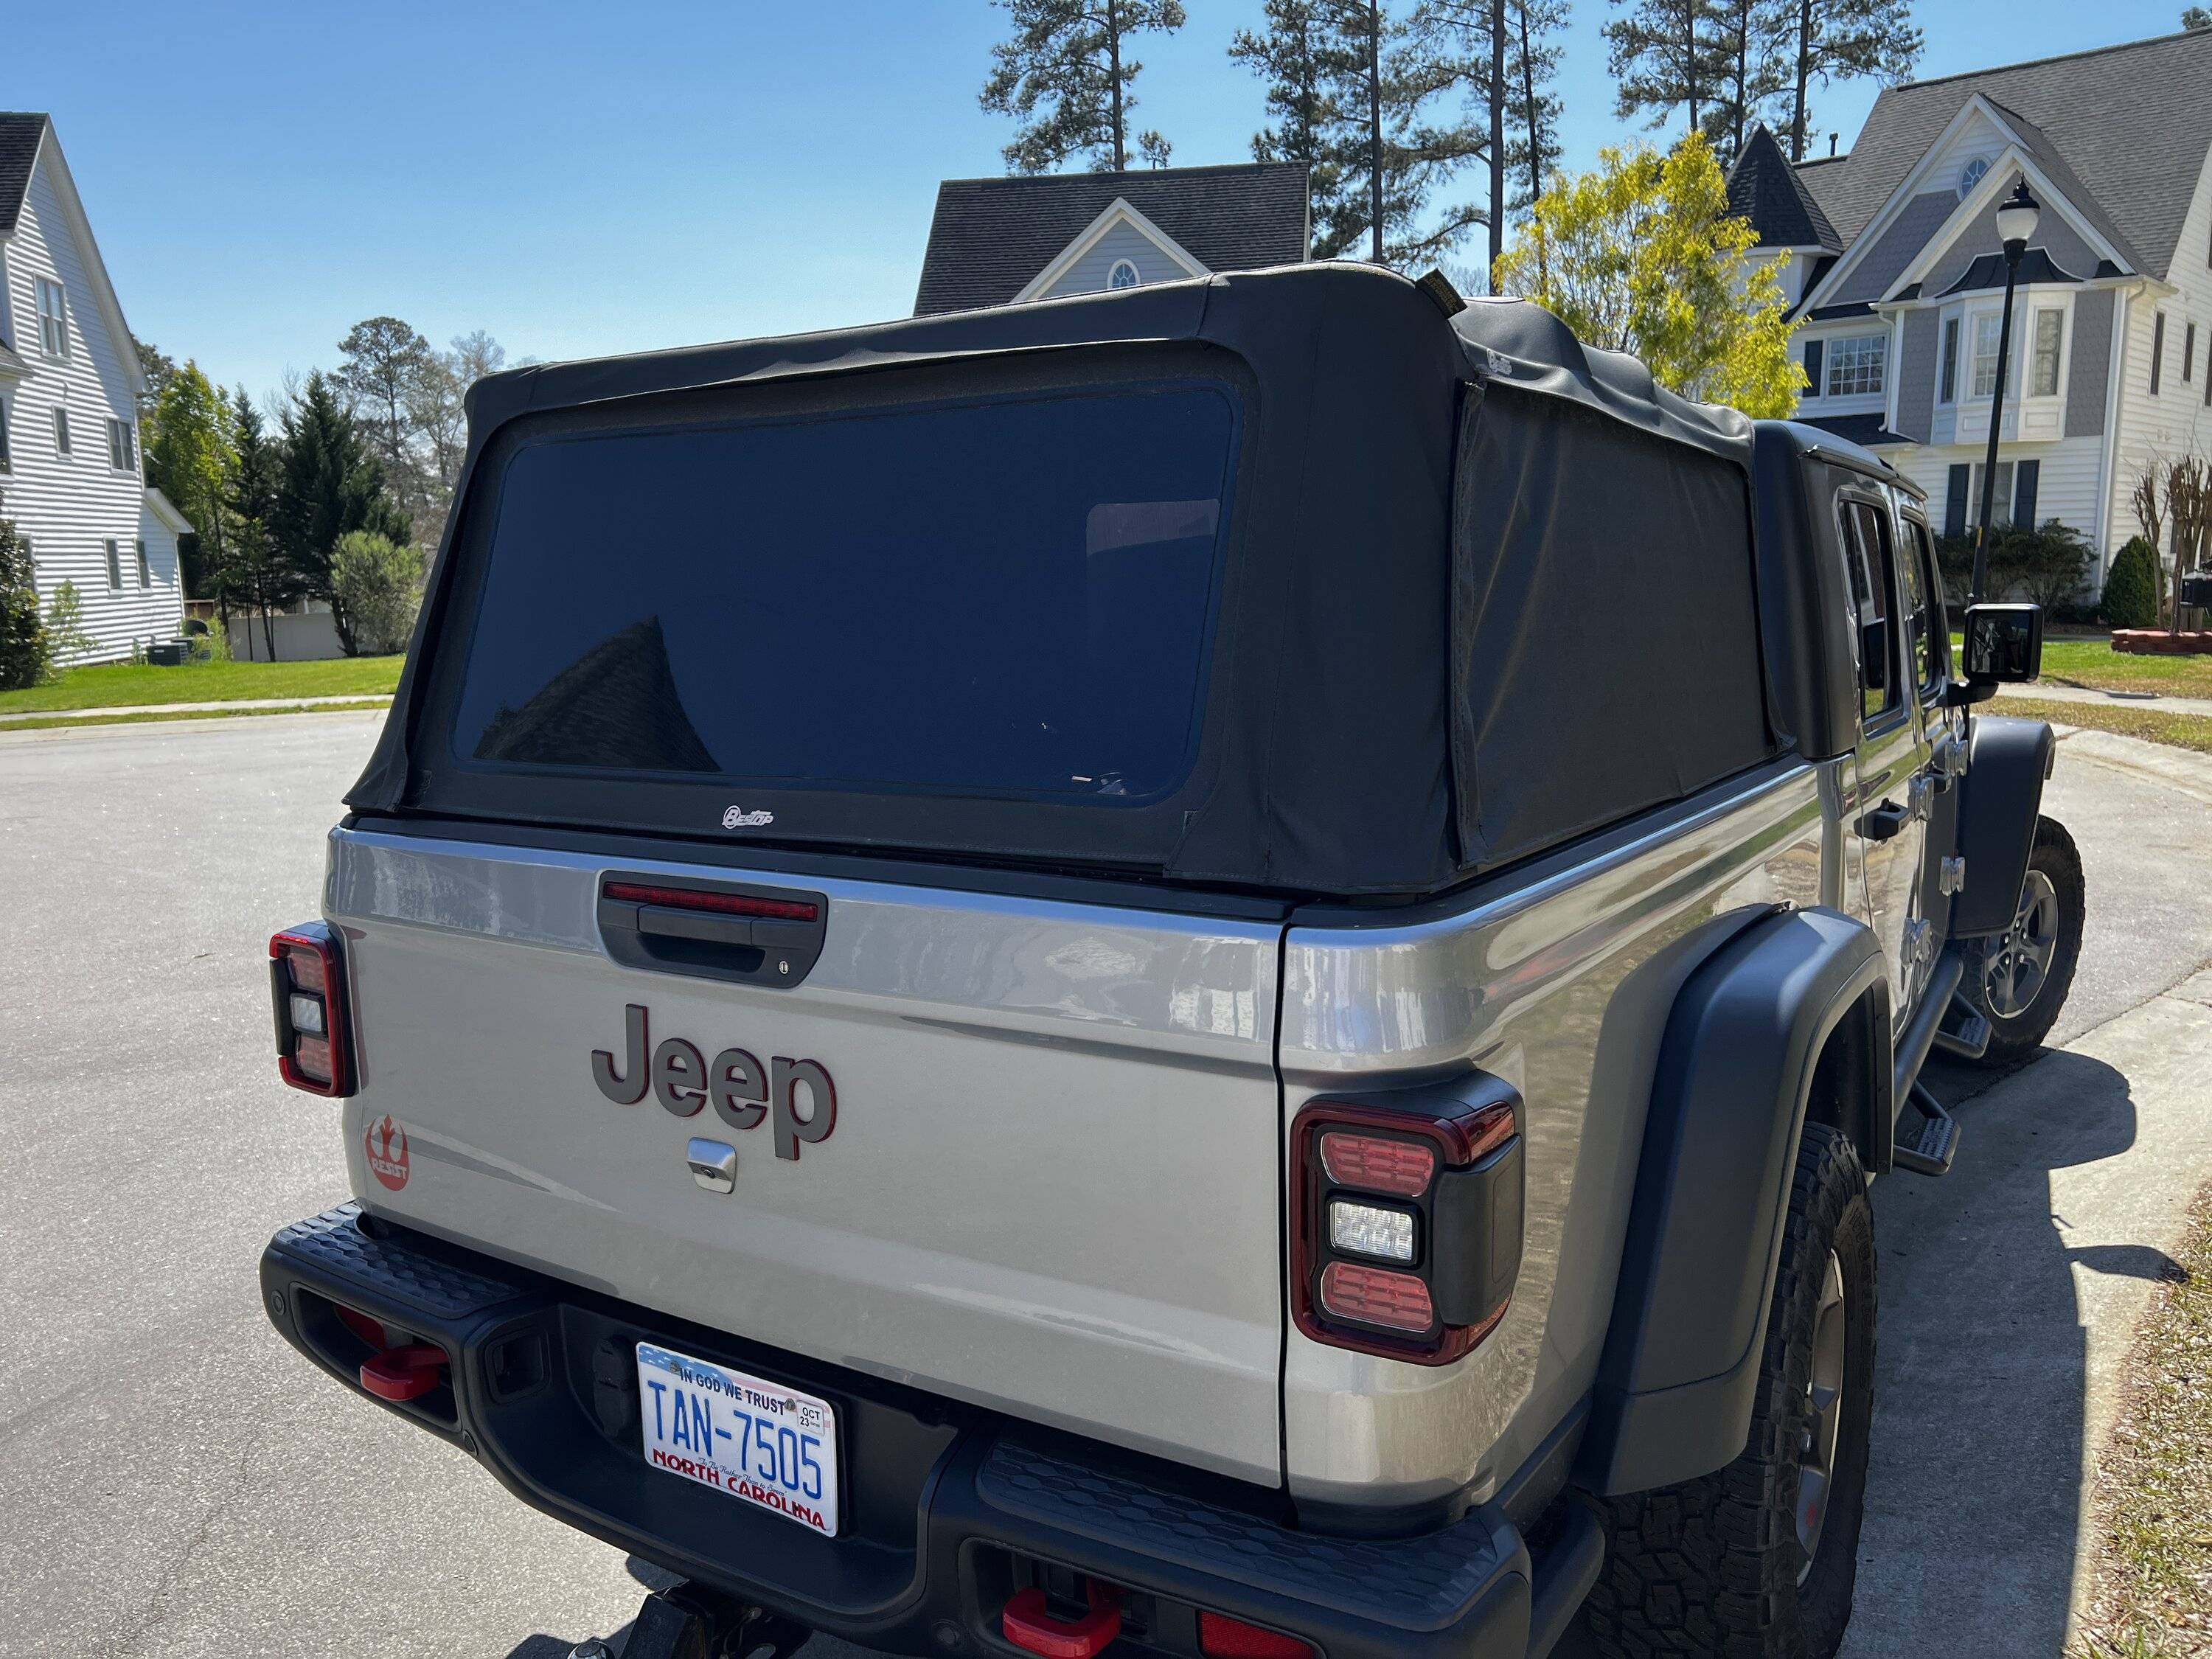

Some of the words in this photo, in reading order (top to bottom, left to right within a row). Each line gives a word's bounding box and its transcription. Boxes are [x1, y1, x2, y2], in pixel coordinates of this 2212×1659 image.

[591, 1003, 838, 1161] Jeep
[371, 1158, 408, 1180] RESIST
[680, 1368, 693, 1384] IN
[696, 1373, 720, 1393] GOD
[724, 1382, 742, 1401] WE
[745, 1389, 785, 1416] TRUST
[802, 1407, 820, 1421] OCT
[647, 1380, 822, 1500] TAN-7505
[800, 1416, 810, 1427] 23
[653, 1448, 720, 1486] NORTH
[727, 1477, 827, 1531] CAROLINA
